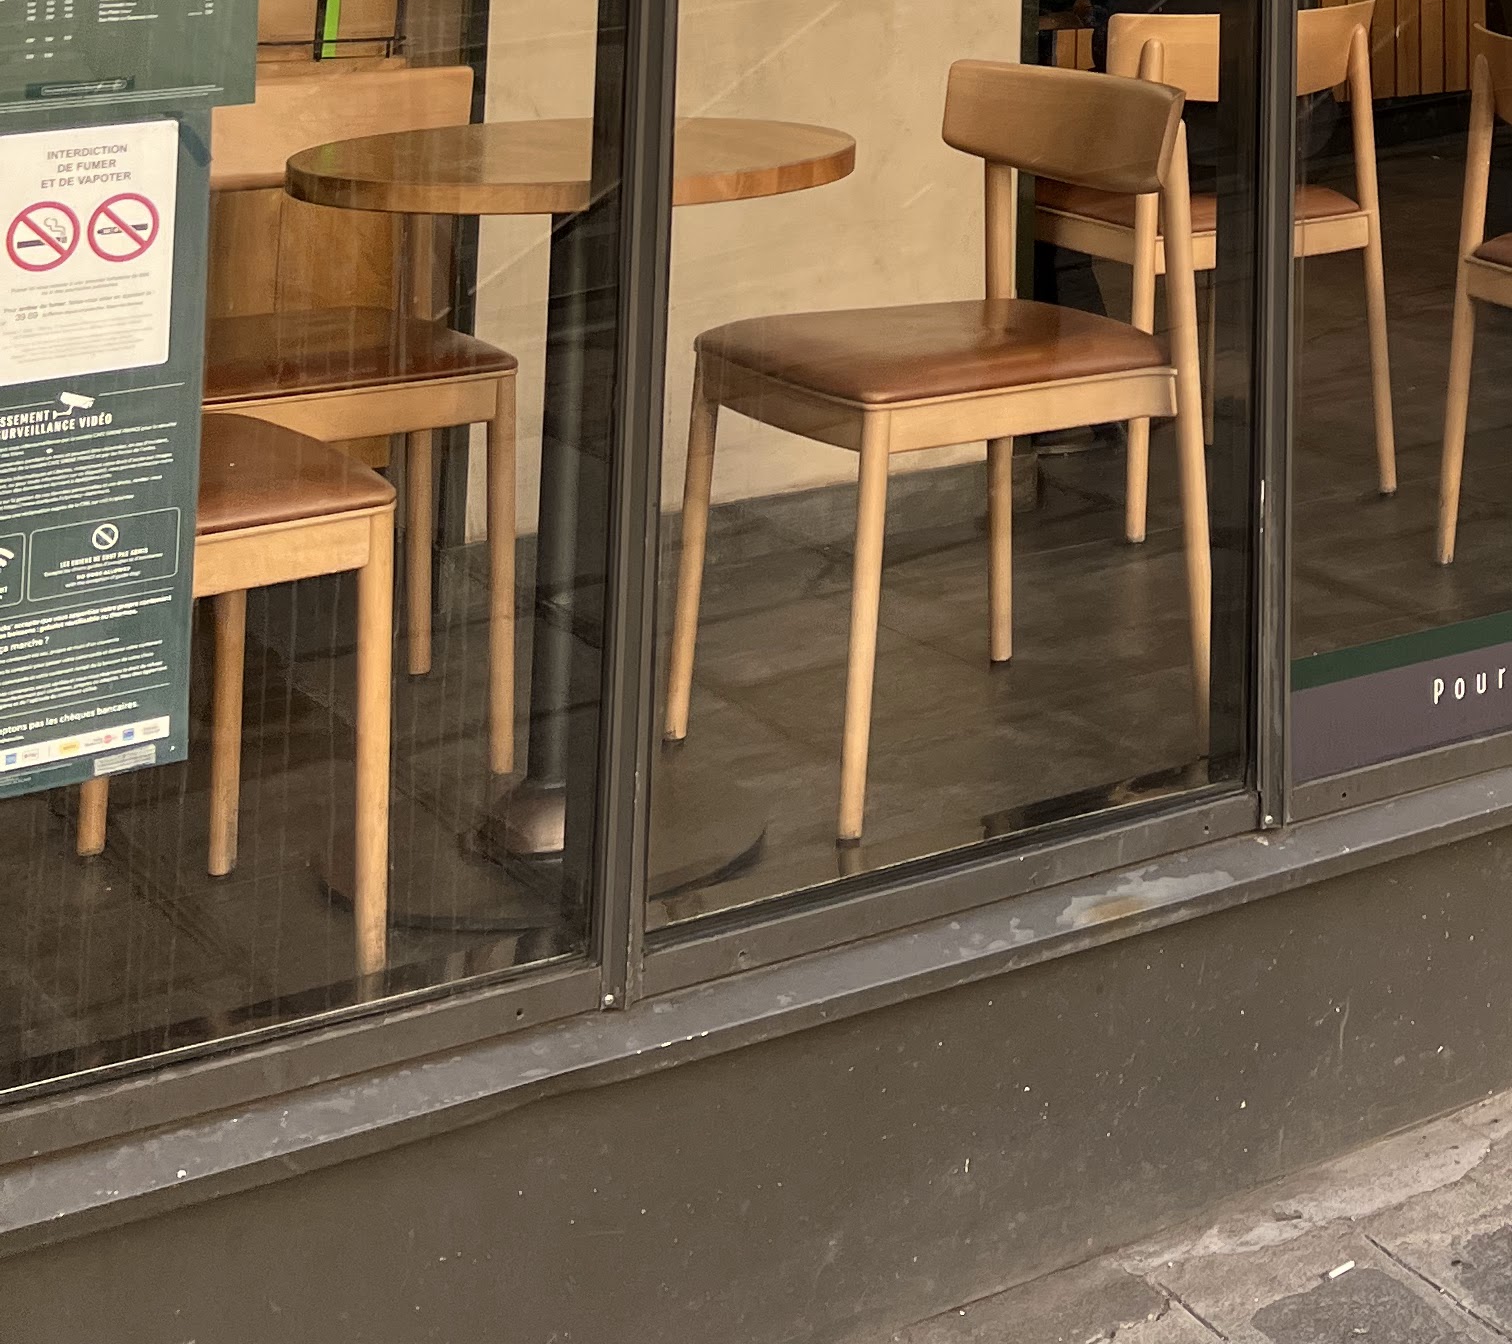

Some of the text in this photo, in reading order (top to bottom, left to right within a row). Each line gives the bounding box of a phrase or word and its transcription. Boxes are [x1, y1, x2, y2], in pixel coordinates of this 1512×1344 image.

[47, 143, 128, 161] INTERDICTION
[57, 159, 117, 174] DE FUMER
[40, 171, 132, 190] ET DE VAPOTER
[79, 411, 113, 429] VIDÉO
[10, 639, 43, 652] marche
[44, 636, 50, 644] ?
[1433, 664, 1508, 706] Pour
[28, 720, 45, 731] pas
[45, 716, 59, 728] les
[59, 710, 96, 725] chèques
